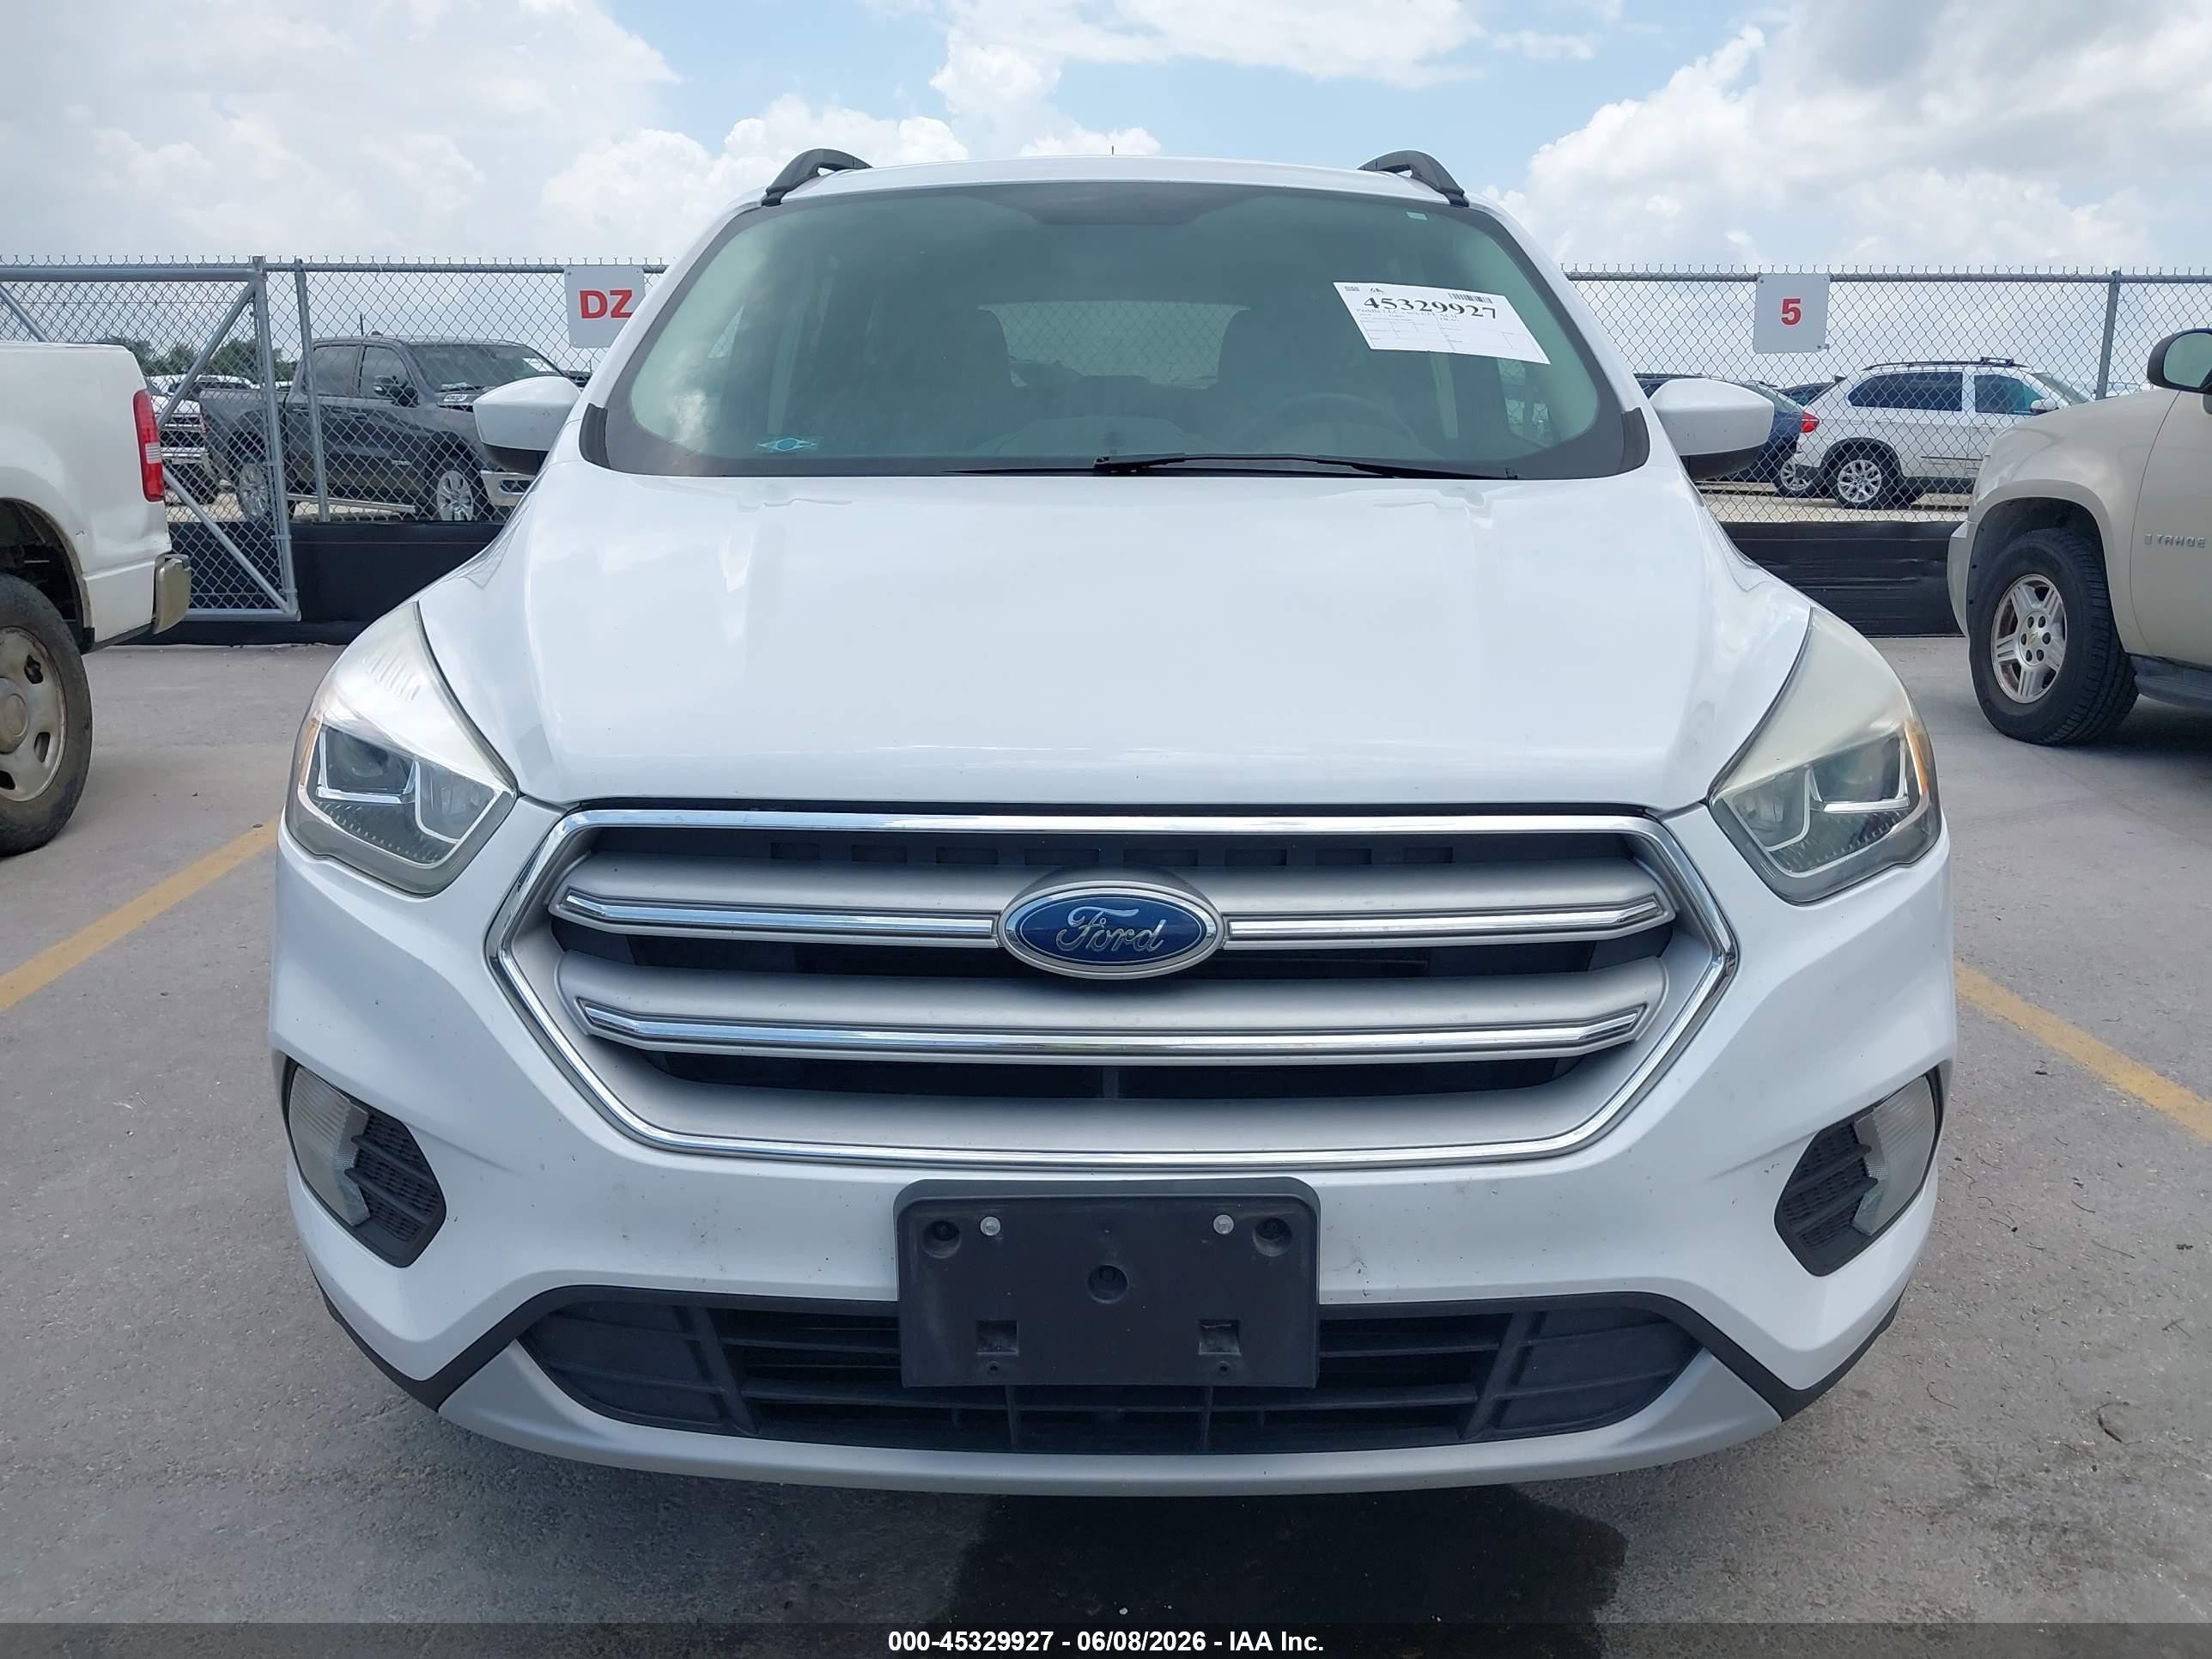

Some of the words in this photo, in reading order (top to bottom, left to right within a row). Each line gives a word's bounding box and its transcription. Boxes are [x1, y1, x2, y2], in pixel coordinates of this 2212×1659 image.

[579, 289, 634, 319] DZ
[1364, 297, 1496, 319] 45329927
[1781, 298, 1802, 325] 5
[2156, 534, 2206, 549] TAHOE
[1056, 906, 1165, 952] Ford
